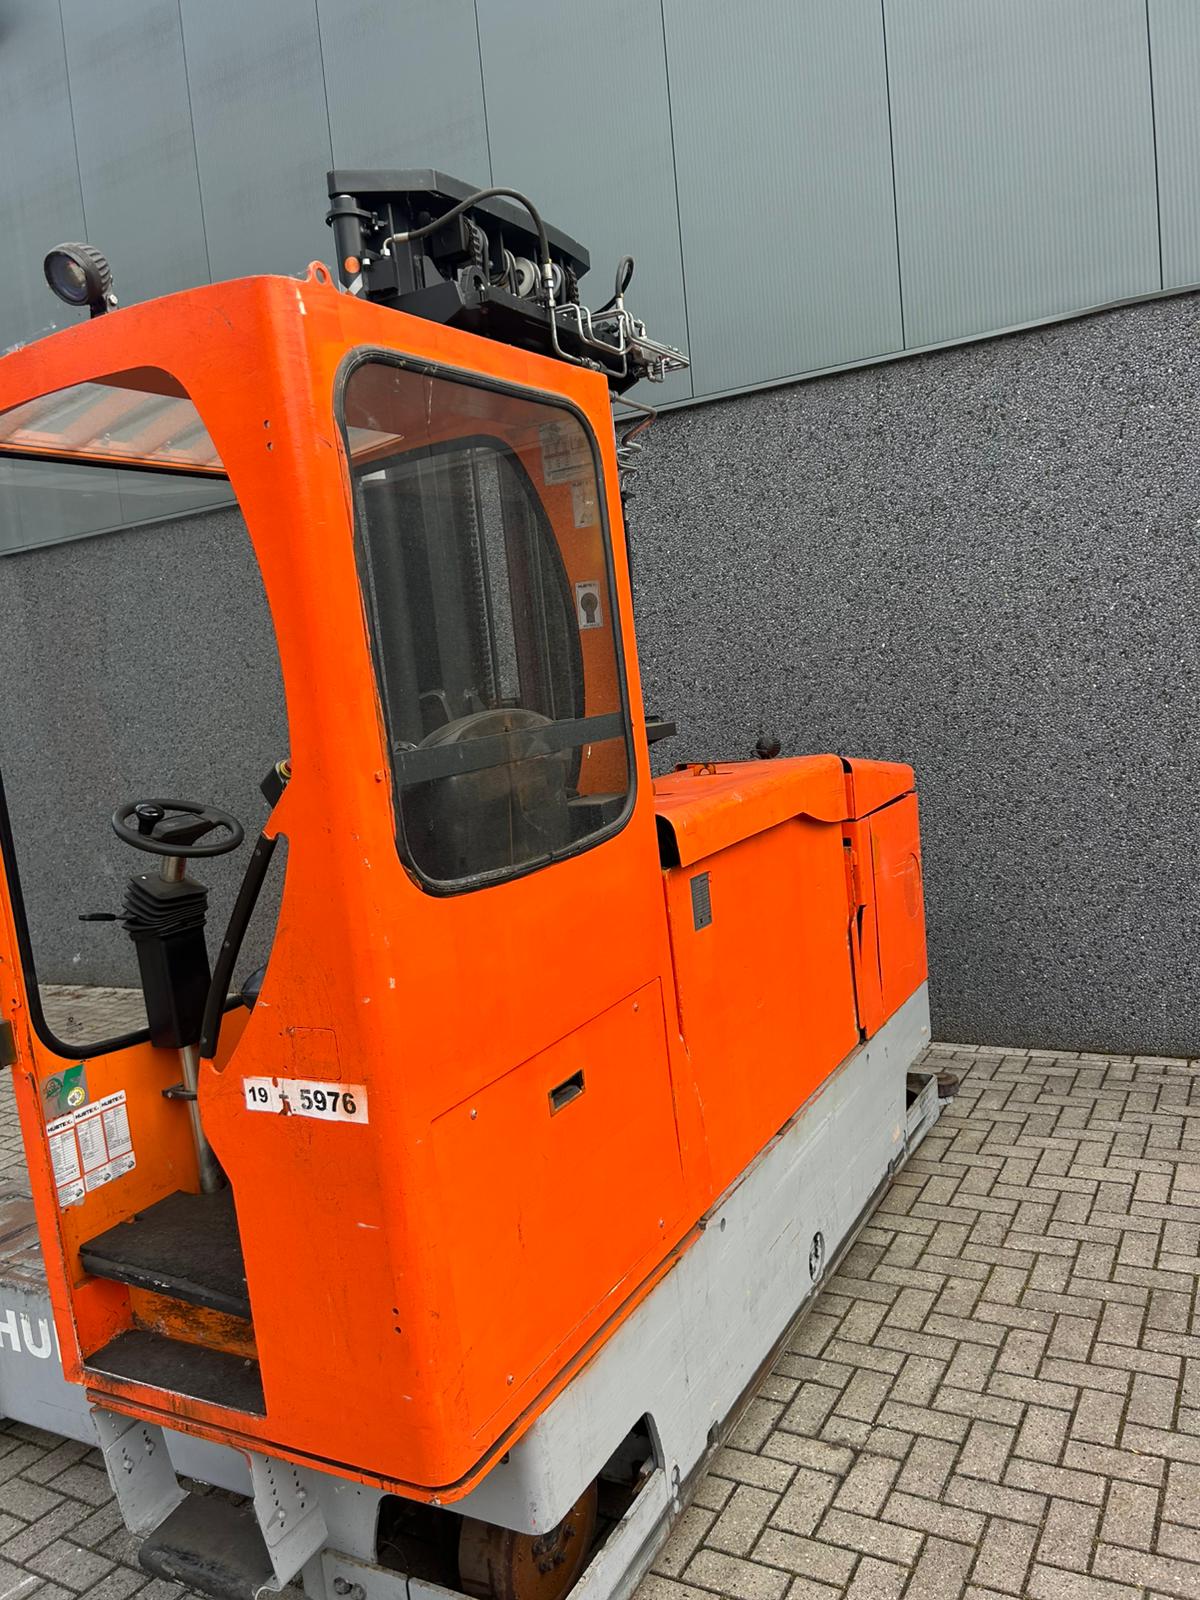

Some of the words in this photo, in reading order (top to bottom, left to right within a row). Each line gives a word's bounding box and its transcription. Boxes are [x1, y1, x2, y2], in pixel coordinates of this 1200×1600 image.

[249, 1086, 268, 1103] 19
[300, 1089, 357, 1115] 5976
[0, 1309, 62, 1363] HU
